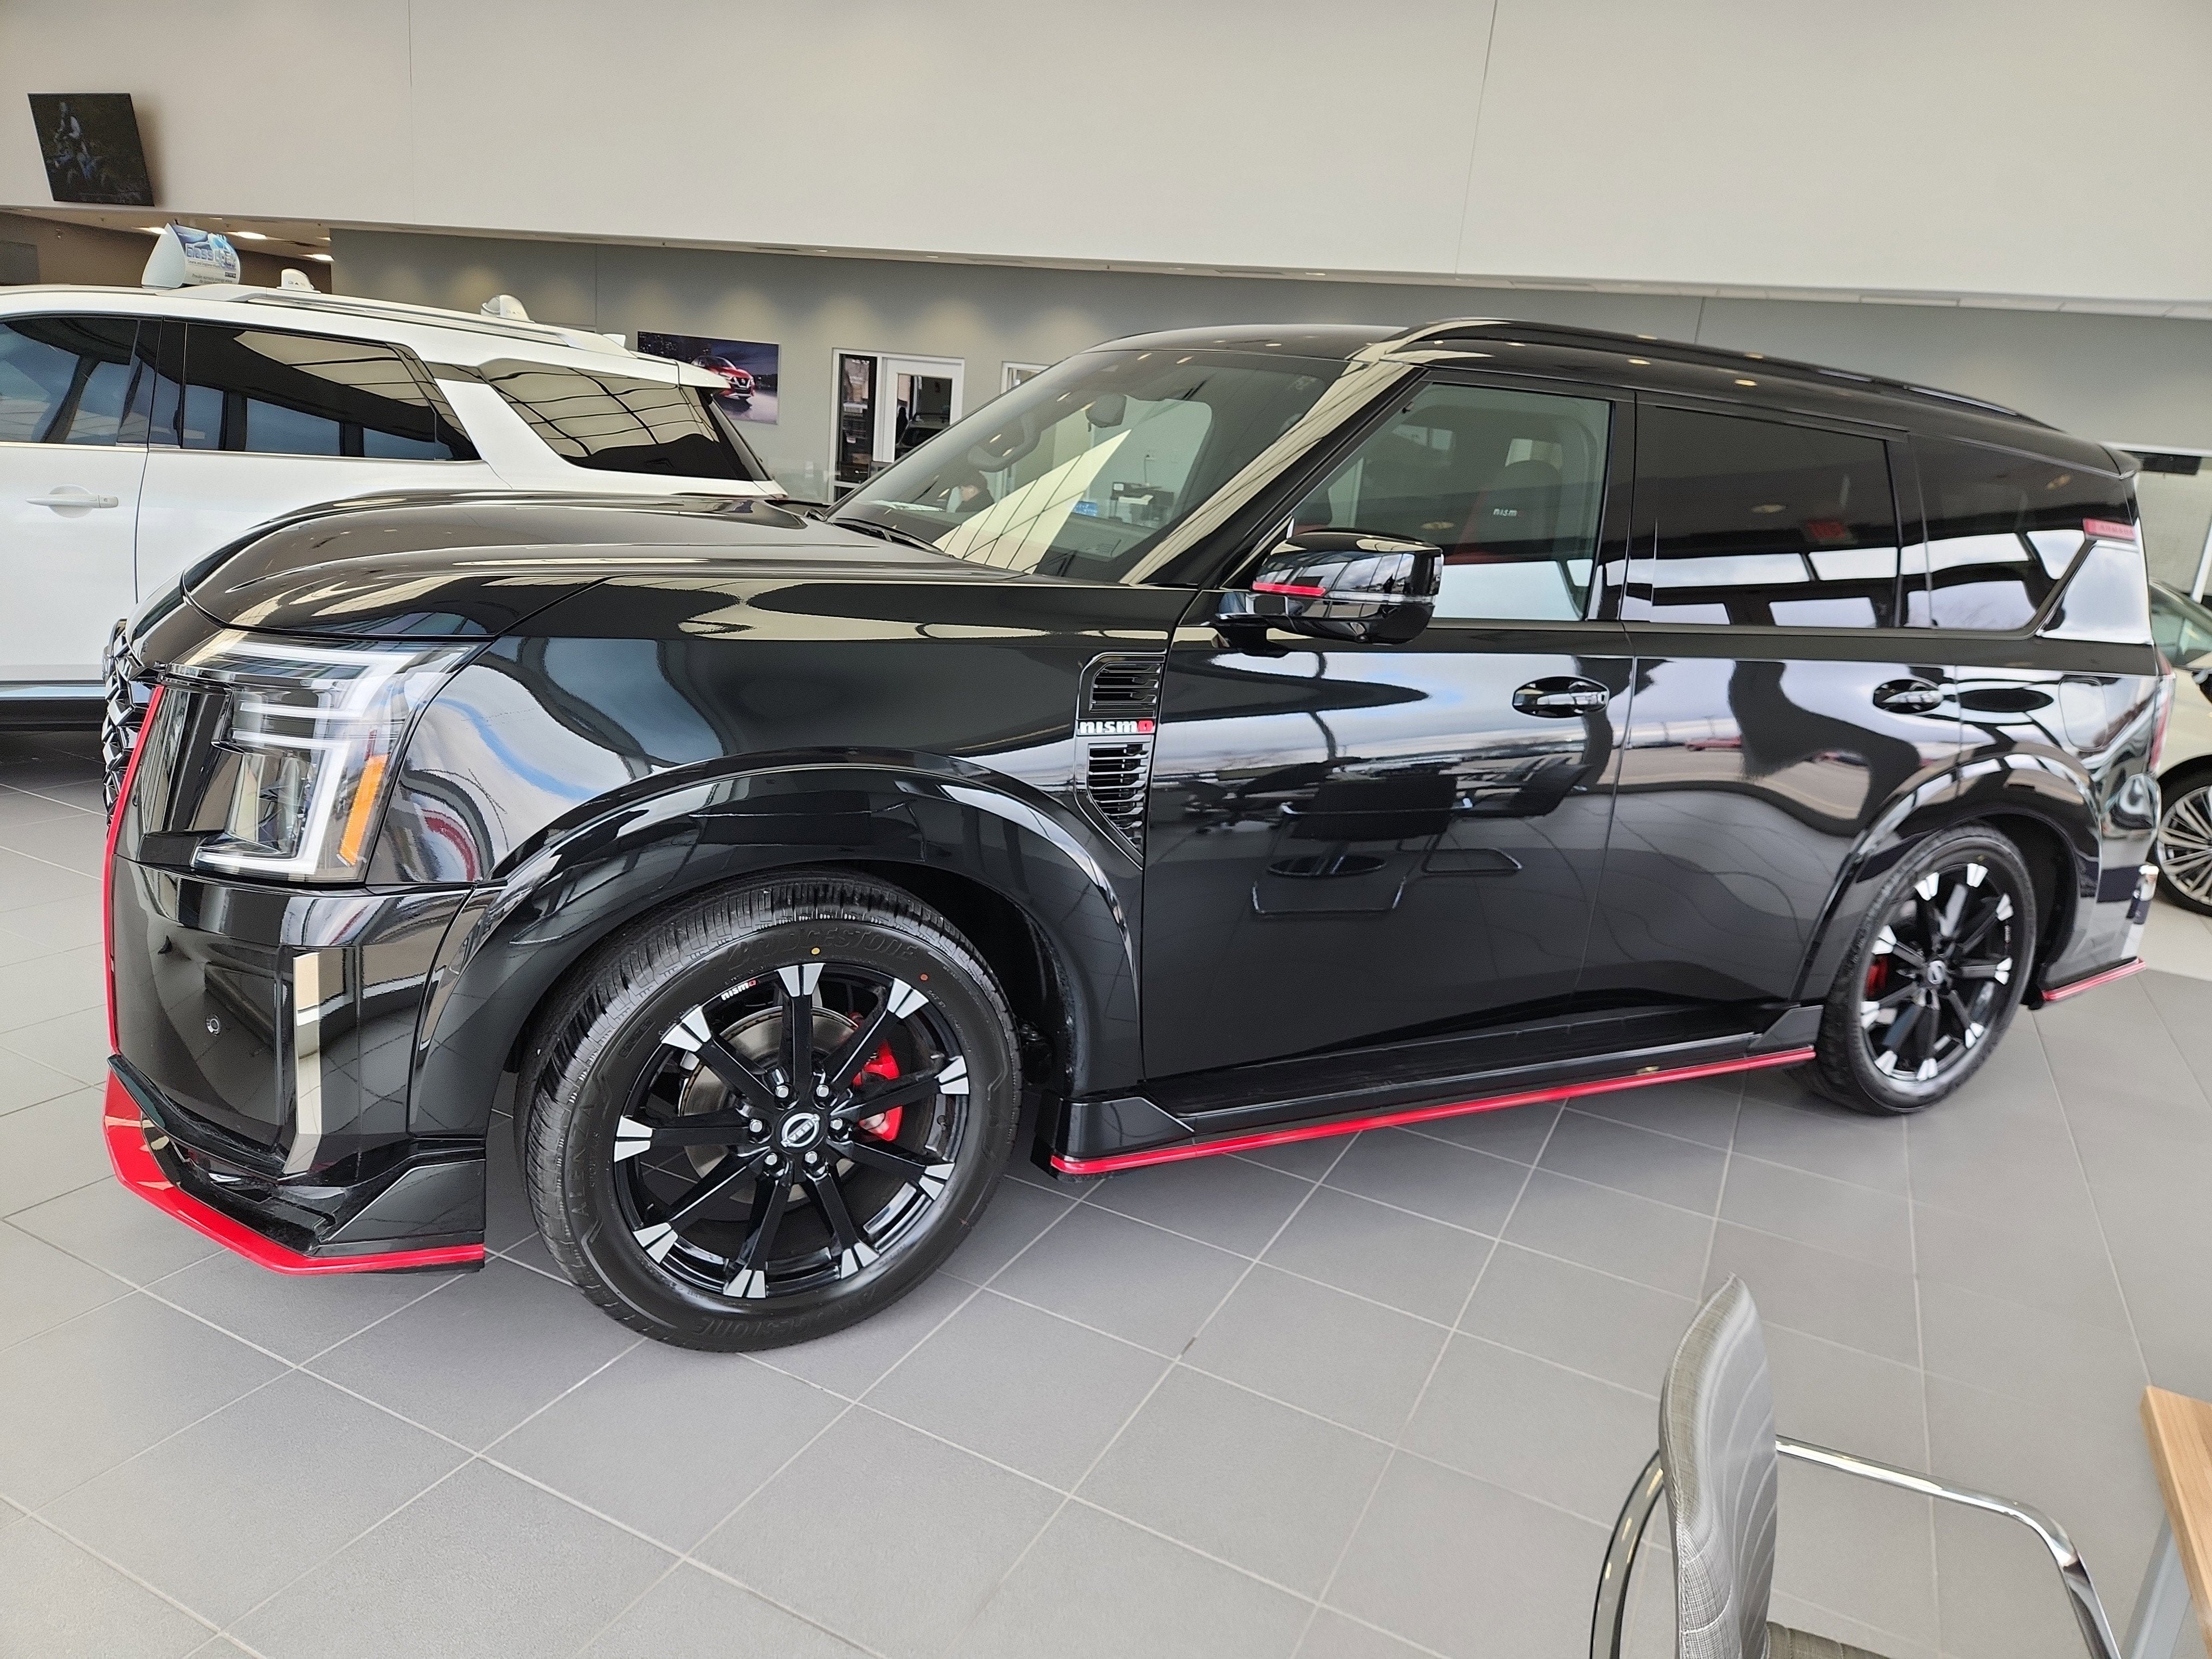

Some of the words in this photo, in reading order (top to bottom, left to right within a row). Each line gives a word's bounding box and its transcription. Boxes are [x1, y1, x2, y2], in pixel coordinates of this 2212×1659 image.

[185, 243, 213, 260] Glass
[1080, 720, 1153, 734] nismo
[721, 980, 756, 1000] nismo
[781, 1114, 820, 1147] NISSAN
[568, 1104, 594, 1217] ALENZA
